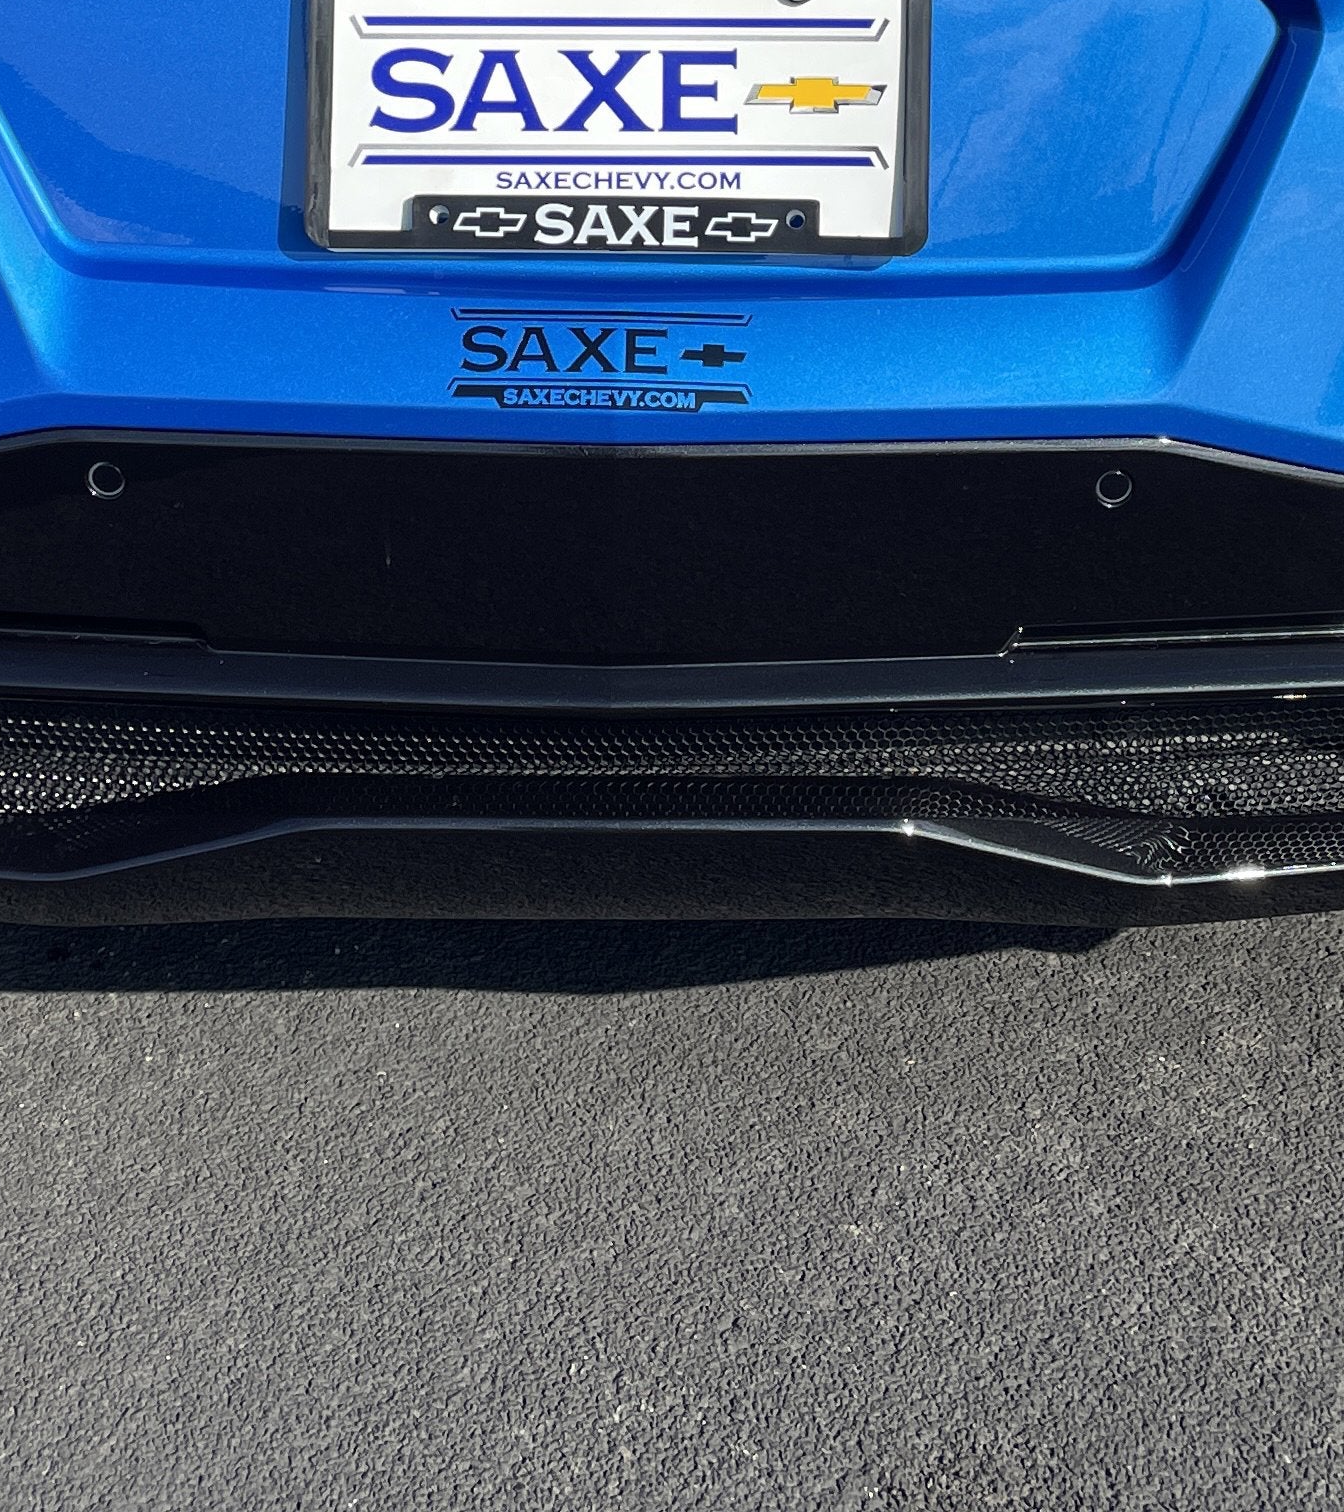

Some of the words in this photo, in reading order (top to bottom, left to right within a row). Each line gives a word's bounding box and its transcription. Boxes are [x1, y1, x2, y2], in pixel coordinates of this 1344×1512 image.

[368, 46, 738, 135] SAXE
[495, 171, 742, 190] SAXECHEVY.COM
[533, 202, 699, 248] SAXE
[460, 325, 668, 375] SAXE
[503, 388, 696, 409] SAXECHEVY.COM
